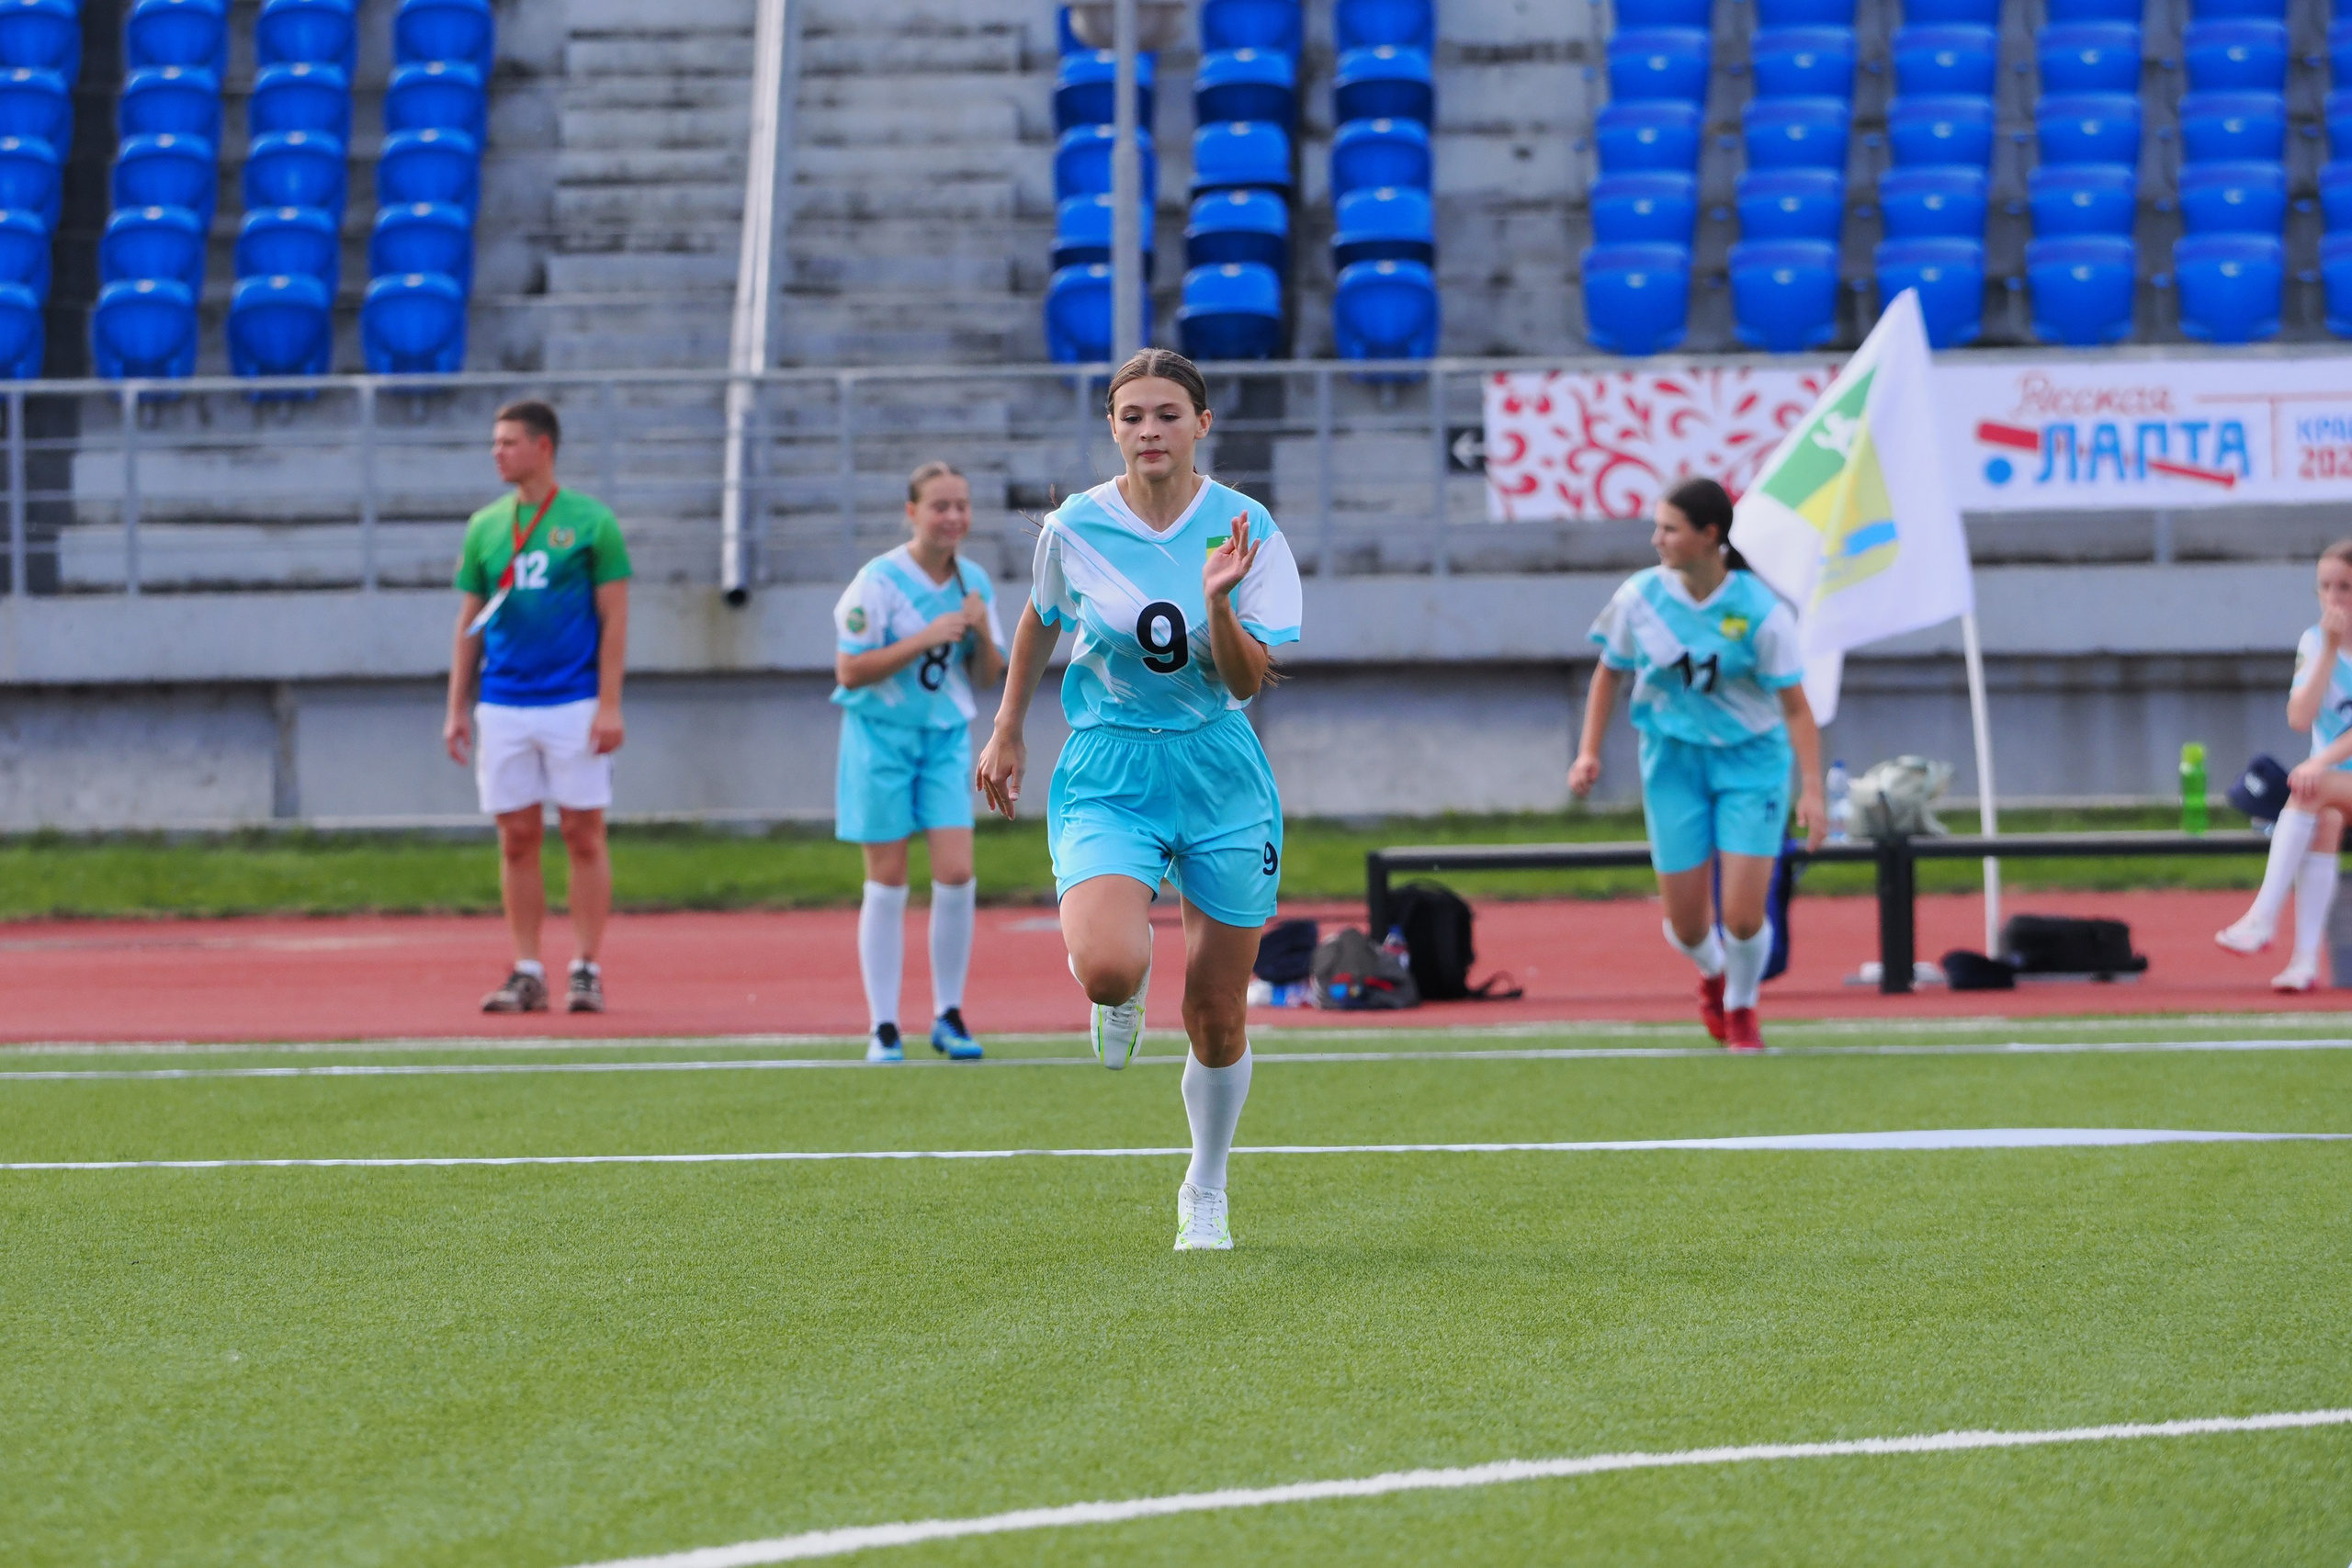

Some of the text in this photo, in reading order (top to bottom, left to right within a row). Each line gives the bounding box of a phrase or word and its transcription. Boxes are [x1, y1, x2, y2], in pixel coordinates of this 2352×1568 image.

[2297, 417, 2352, 441] КРА
[2038, 422, 2250, 482] ЛАПТА
[514, 550, 548, 590] 12
[1136, 601, 1189, 674] 9
[920, 641, 950, 691] 8
[1672, 651, 1717, 693] 11
[1262, 841, 1278, 876] 9
